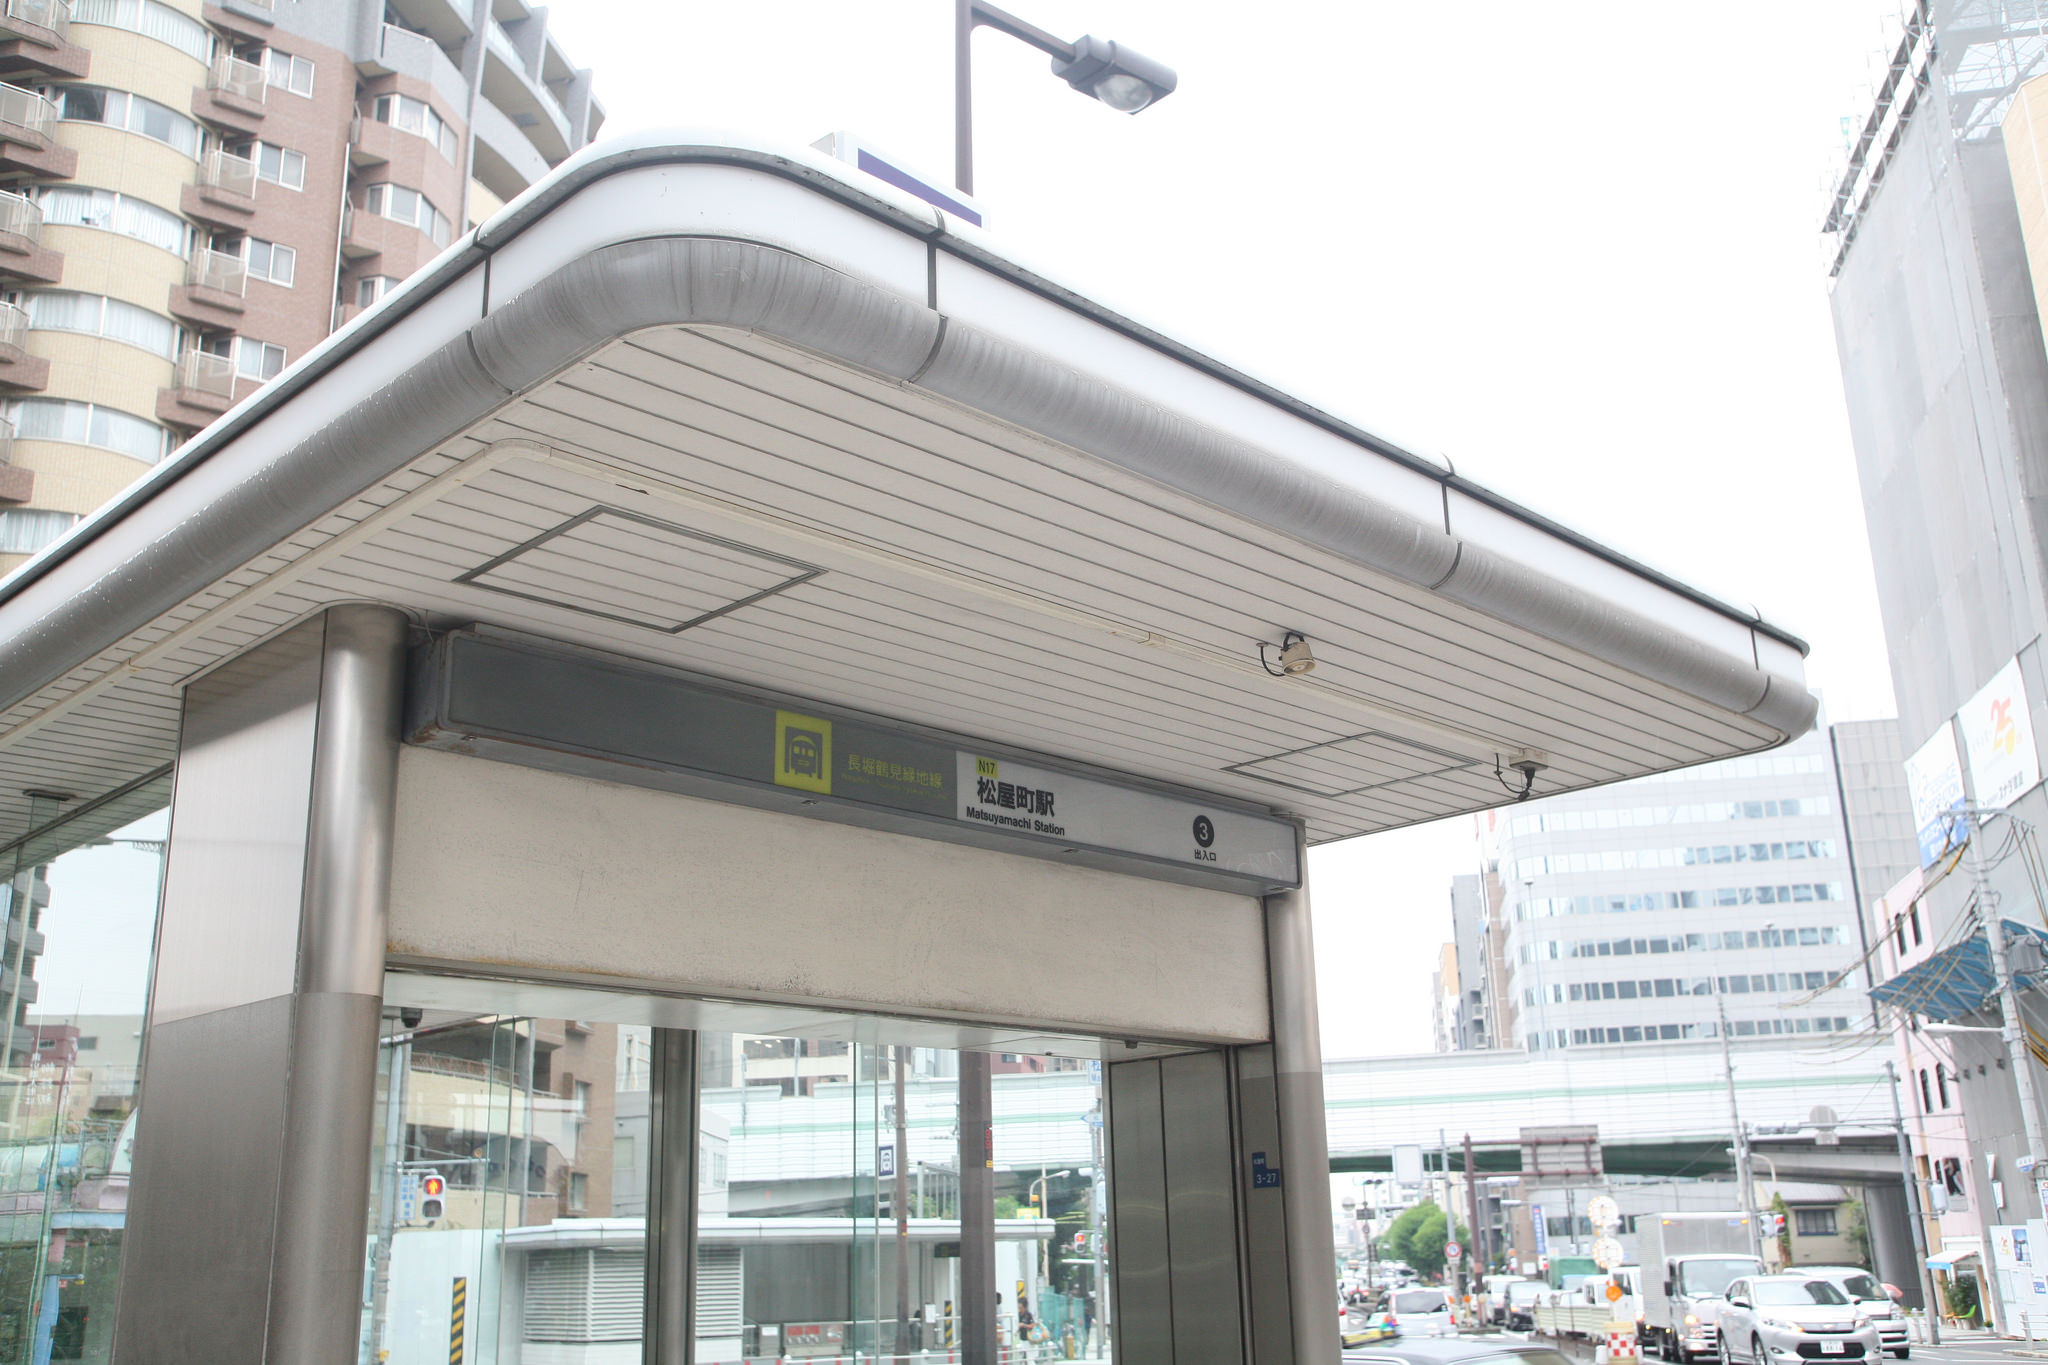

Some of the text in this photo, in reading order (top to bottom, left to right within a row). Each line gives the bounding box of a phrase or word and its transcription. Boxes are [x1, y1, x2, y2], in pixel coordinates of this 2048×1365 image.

[978, 760, 996, 775] N17
[977, 776, 1055, 817] 松屋町駅
[966, 806, 1065, 836] Matsuyamachi Station
[1199, 822, 1209, 841] 3
[1194, 849, 1217, 861] 出入口
[1256, 1173, 1277, 1184] 3-27
